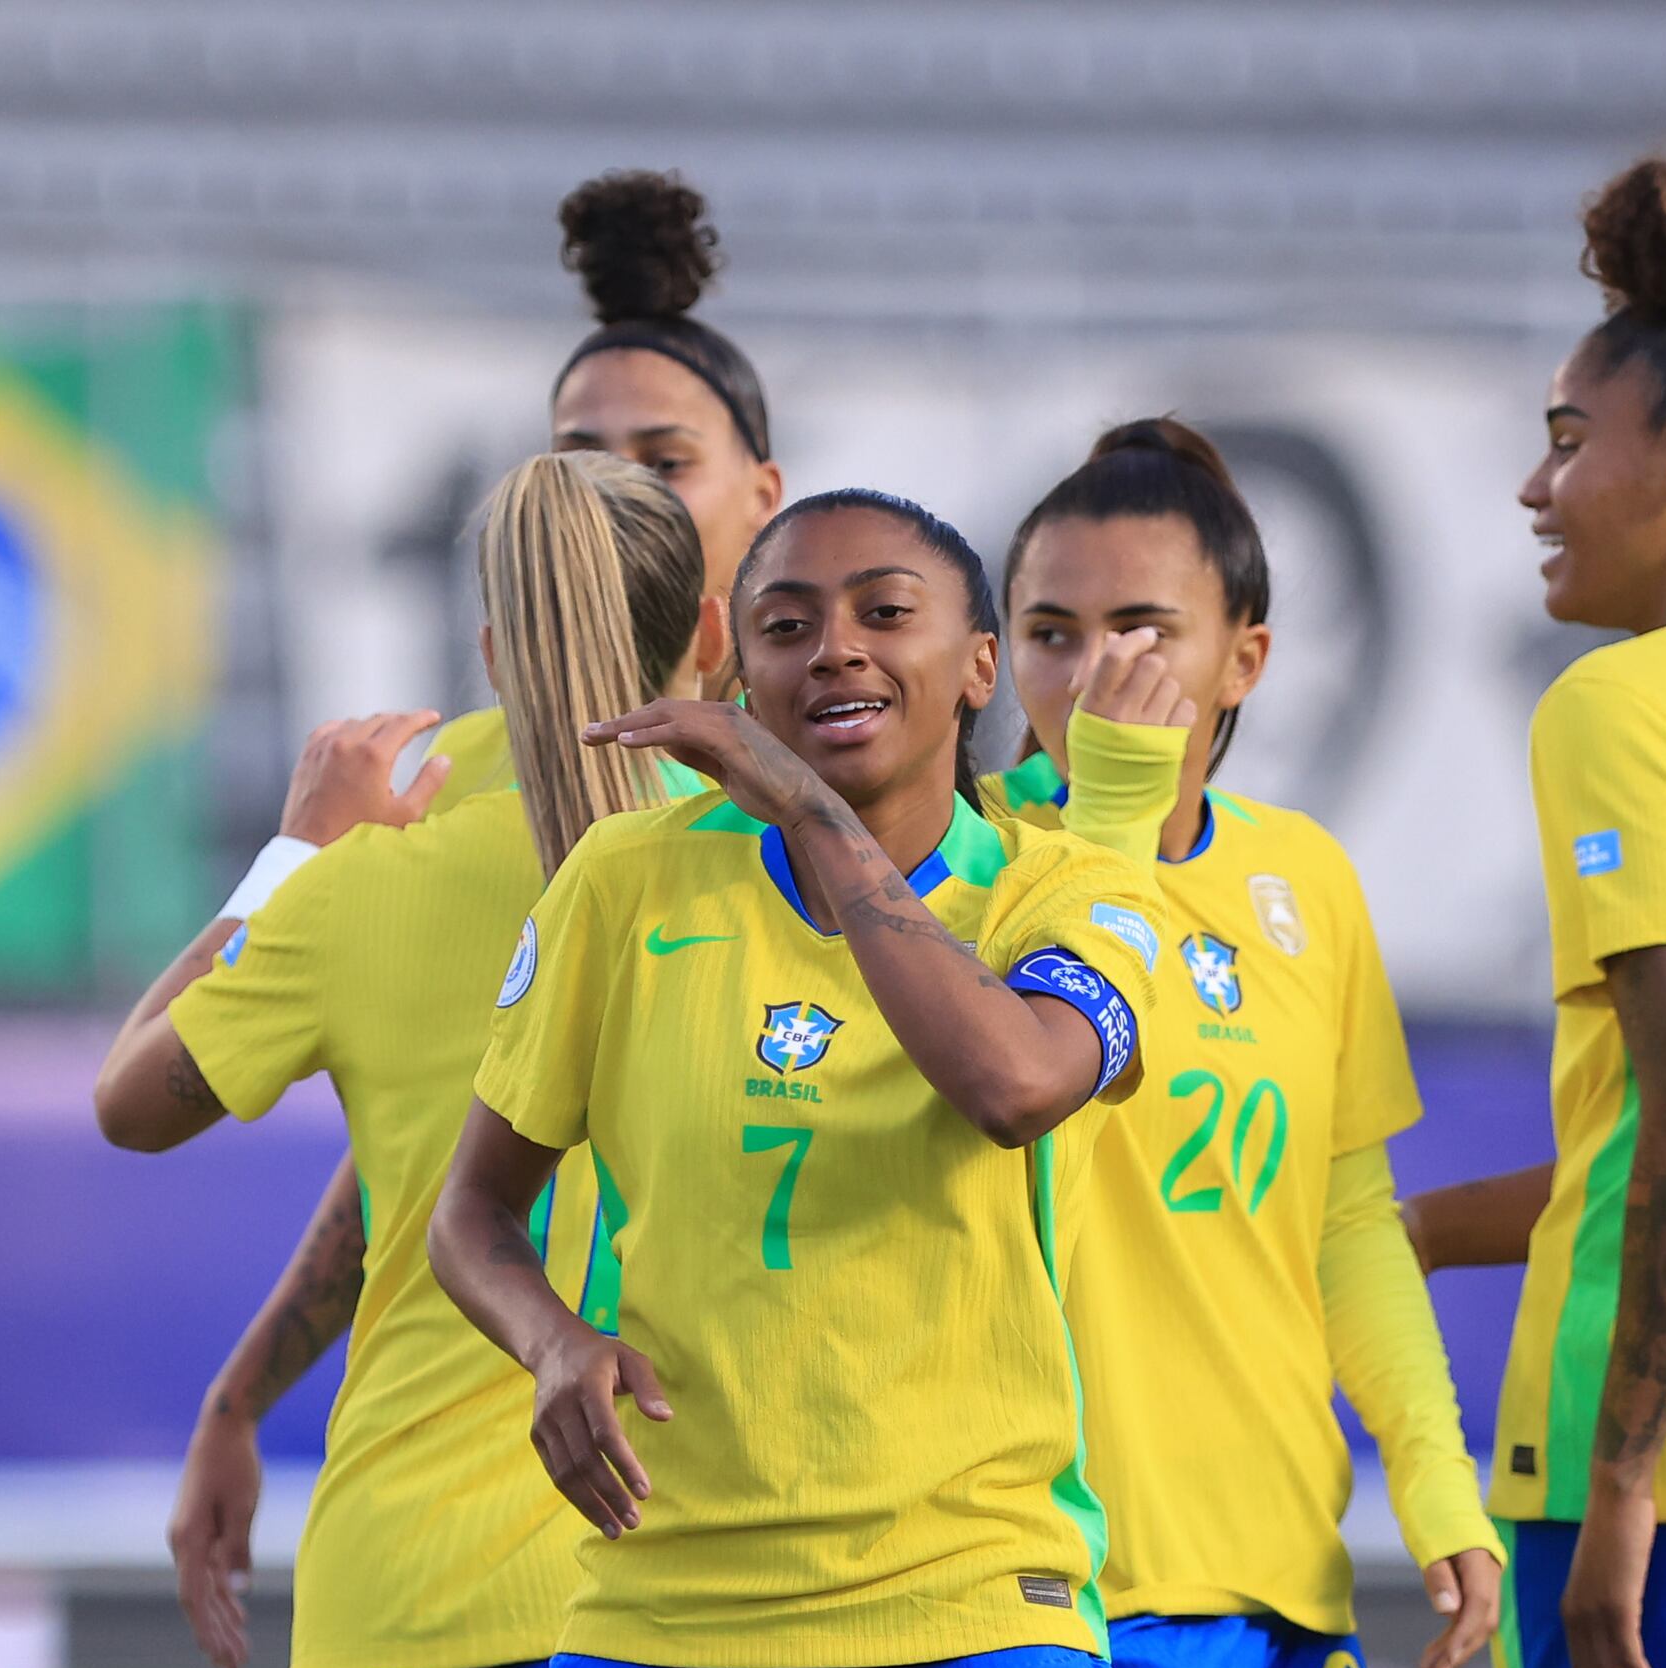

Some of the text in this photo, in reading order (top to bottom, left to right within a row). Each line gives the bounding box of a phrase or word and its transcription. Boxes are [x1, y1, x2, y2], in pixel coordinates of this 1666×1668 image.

[782, 1031, 813, 1043] CBF
[1108, 995, 1131, 1073] ESCO
[1198, 1023, 1258, 1044] BRASIL
[745, 1078, 823, 1104] BRASIL
[1160, 1069, 1288, 1216] 20
[742, 1125, 813, 1270] 7
